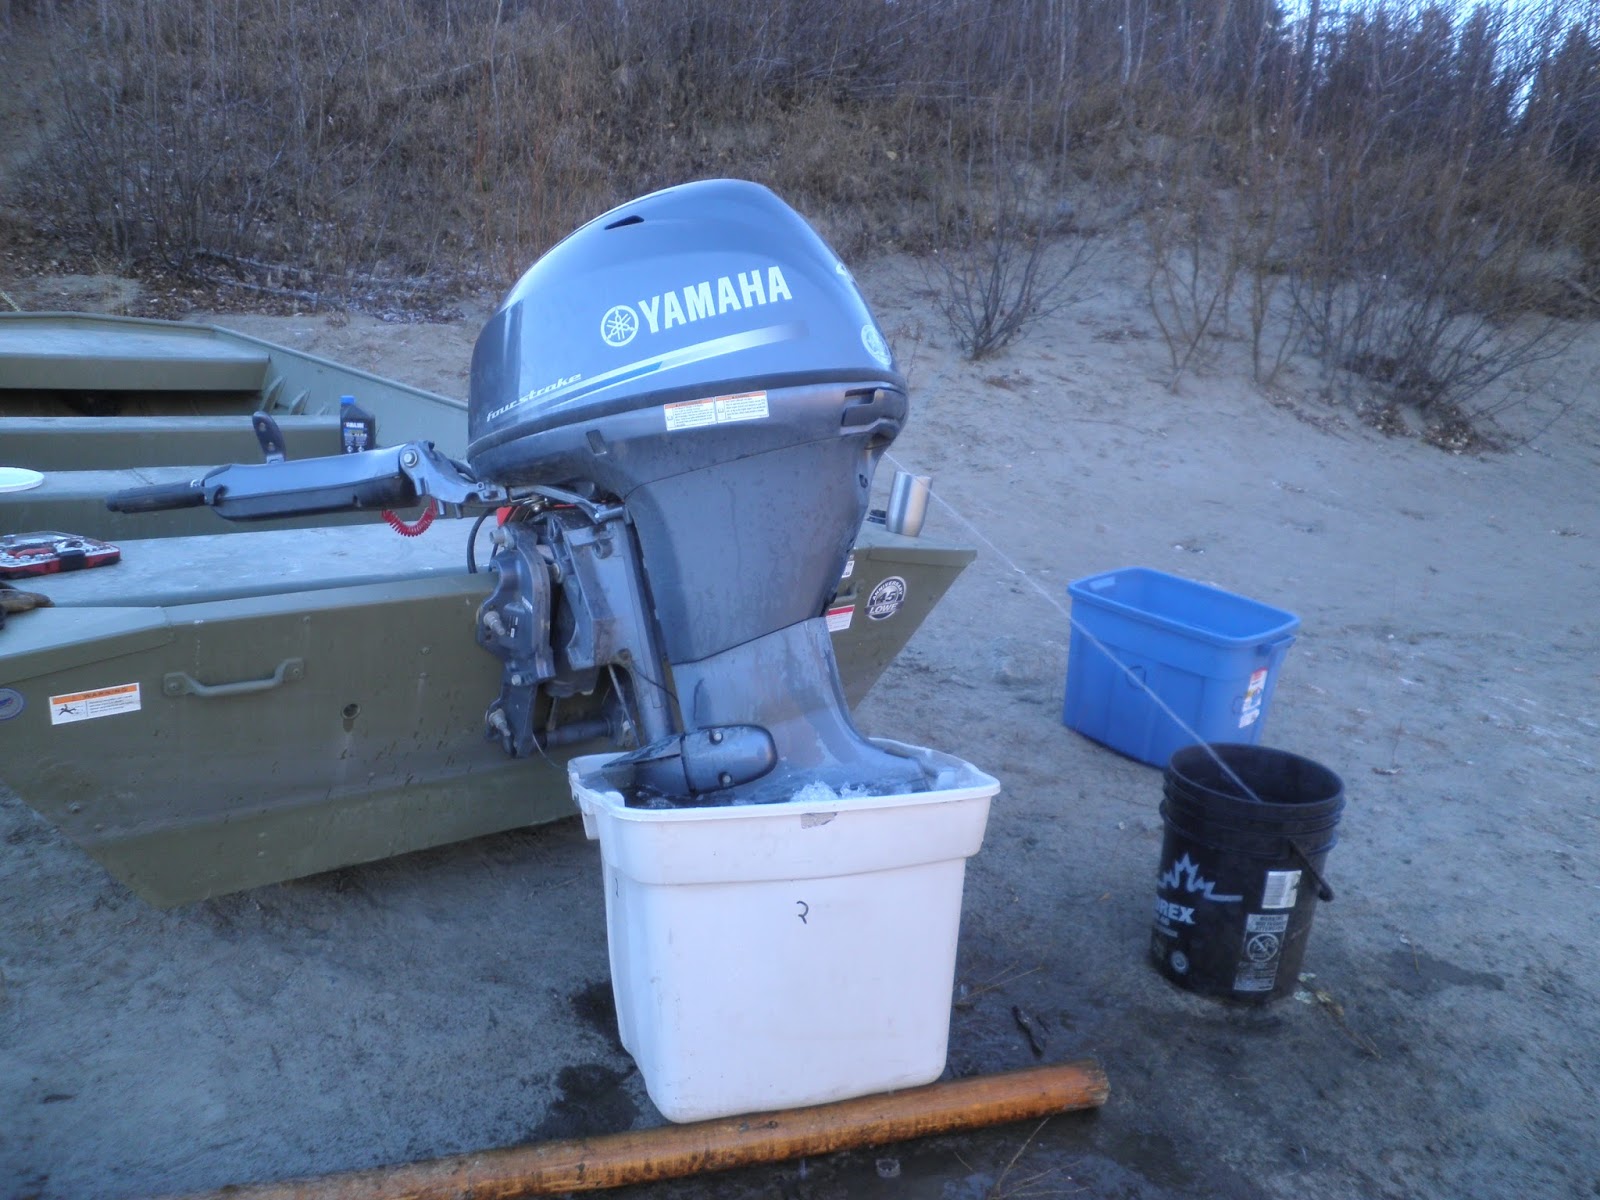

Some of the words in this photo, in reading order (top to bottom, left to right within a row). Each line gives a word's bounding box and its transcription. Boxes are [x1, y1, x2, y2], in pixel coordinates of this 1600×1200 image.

[638, 265, 792, 334] YAMAHA
[872, 580, 903, 600] ANNIVERSARY
[876, 591, 897, 603] 45
[870, 602, 899, 614] LOWE
